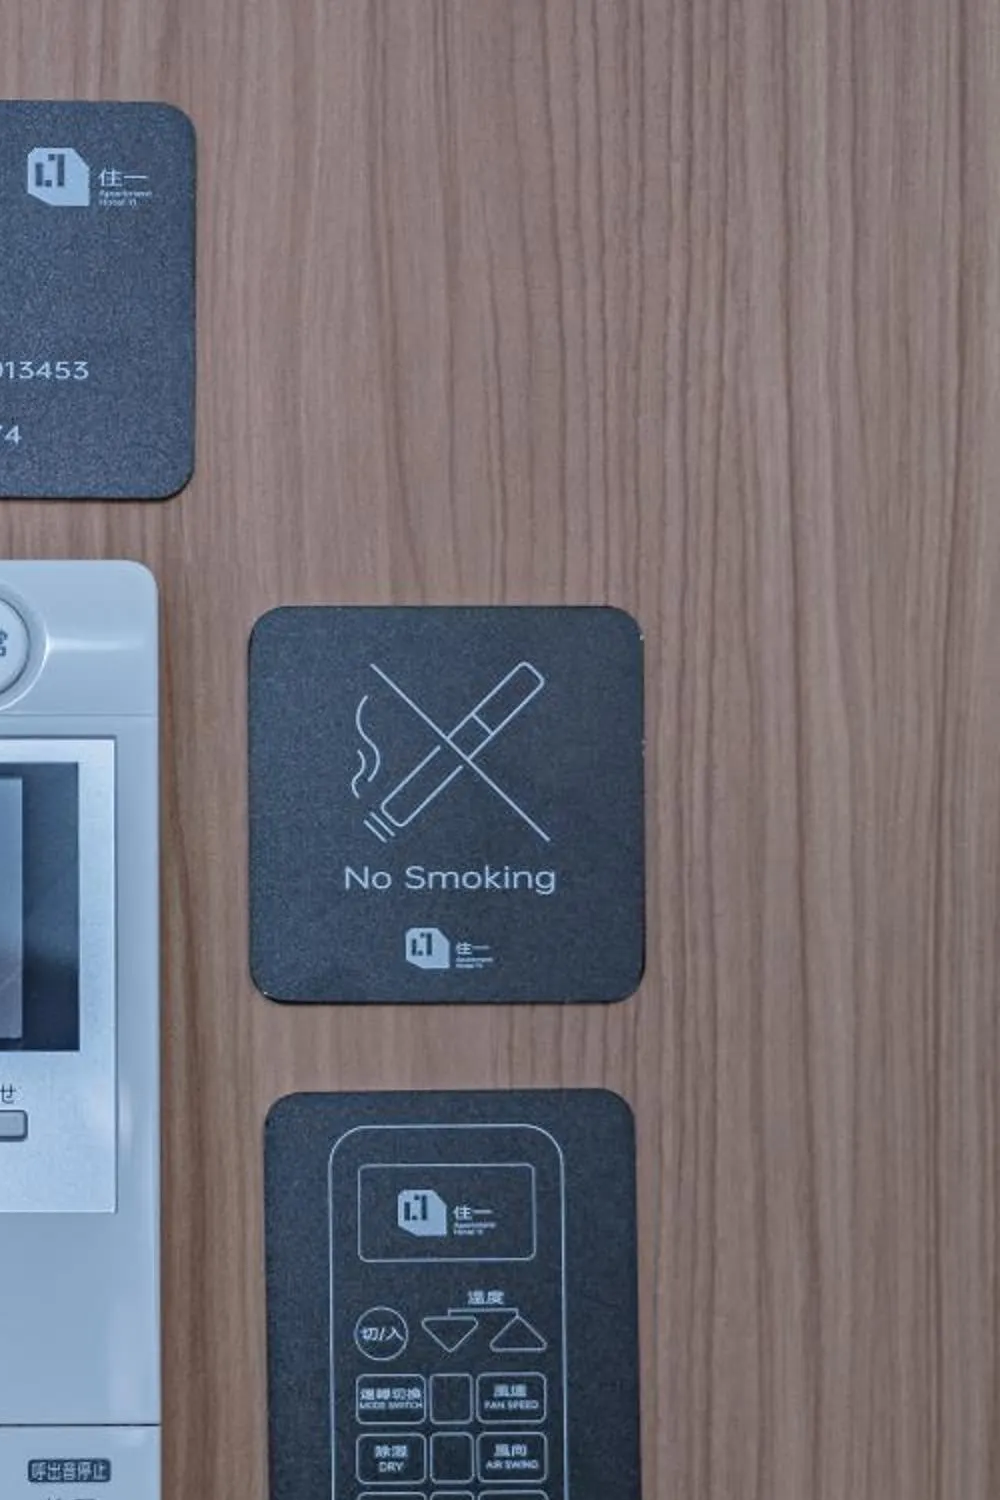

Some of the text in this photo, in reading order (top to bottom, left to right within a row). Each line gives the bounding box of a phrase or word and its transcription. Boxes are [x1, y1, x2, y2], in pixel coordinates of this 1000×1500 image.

[98, 167, 149, 187] 住一
[344, 866, 556, 895] No Smoking
[31, 1461, 108, 1481] 呼出音停止
[379, 1461, 405, 1473] DRY
